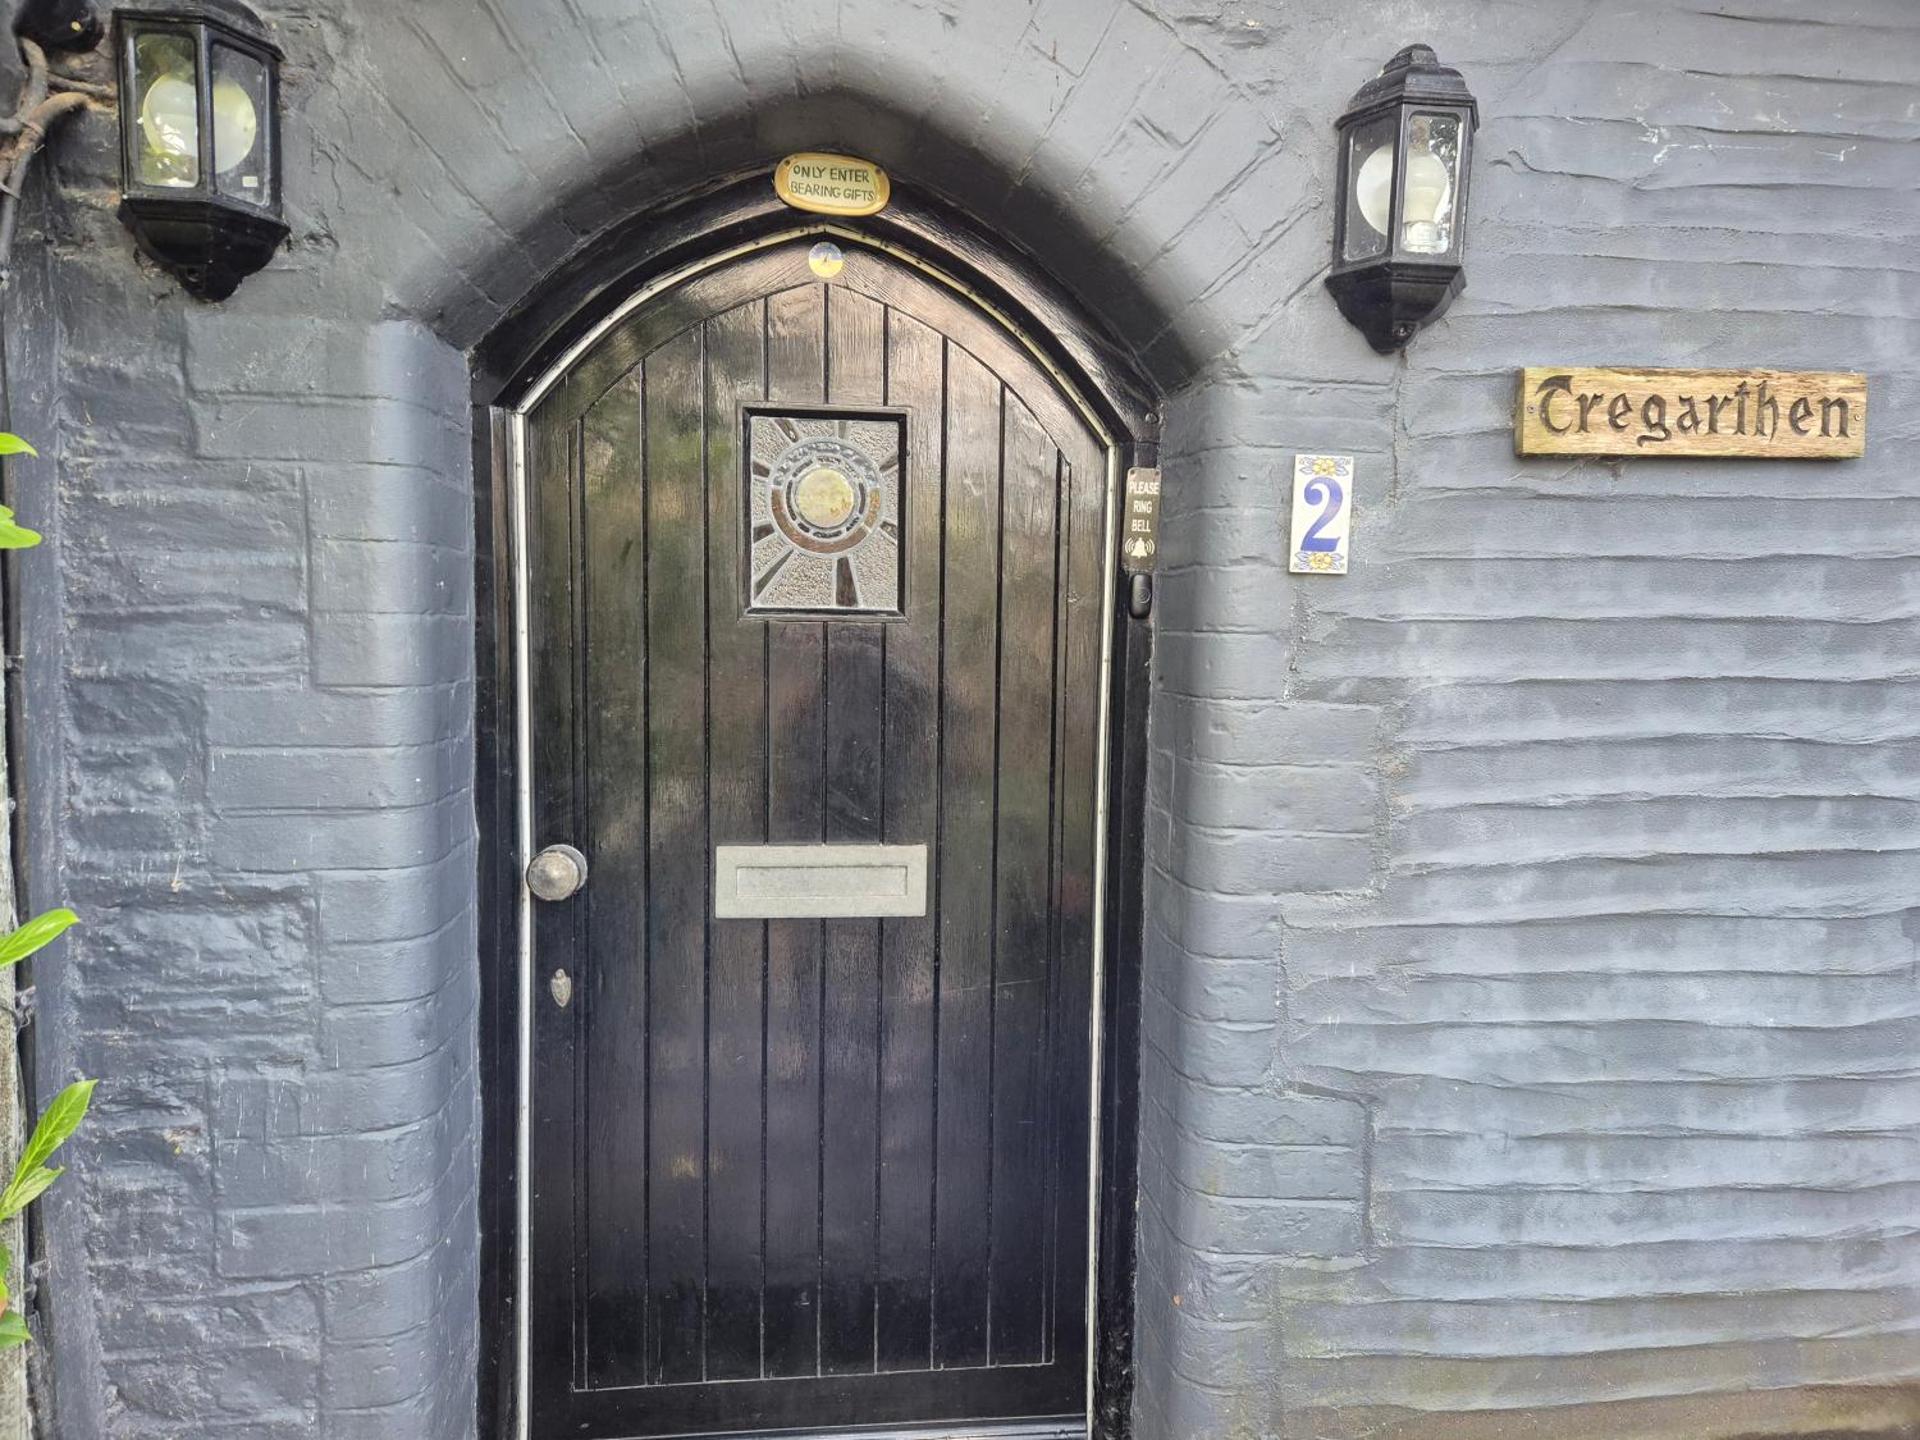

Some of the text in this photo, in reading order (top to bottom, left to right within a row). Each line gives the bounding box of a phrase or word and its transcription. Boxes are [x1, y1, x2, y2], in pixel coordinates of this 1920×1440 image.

[793, 165, 869, 183] ONLY ENTER
[790, 181, 874, 201] BEARING GIFTS
[1535, 375, 1850, 447] Tregarthen
[1129, 481, 1159, 495] PLEASE
[1133, 500, 1152, 513] RING
[1300, 476, 1343, 552] 2
[1131, 519, 1151, 532] BELL
